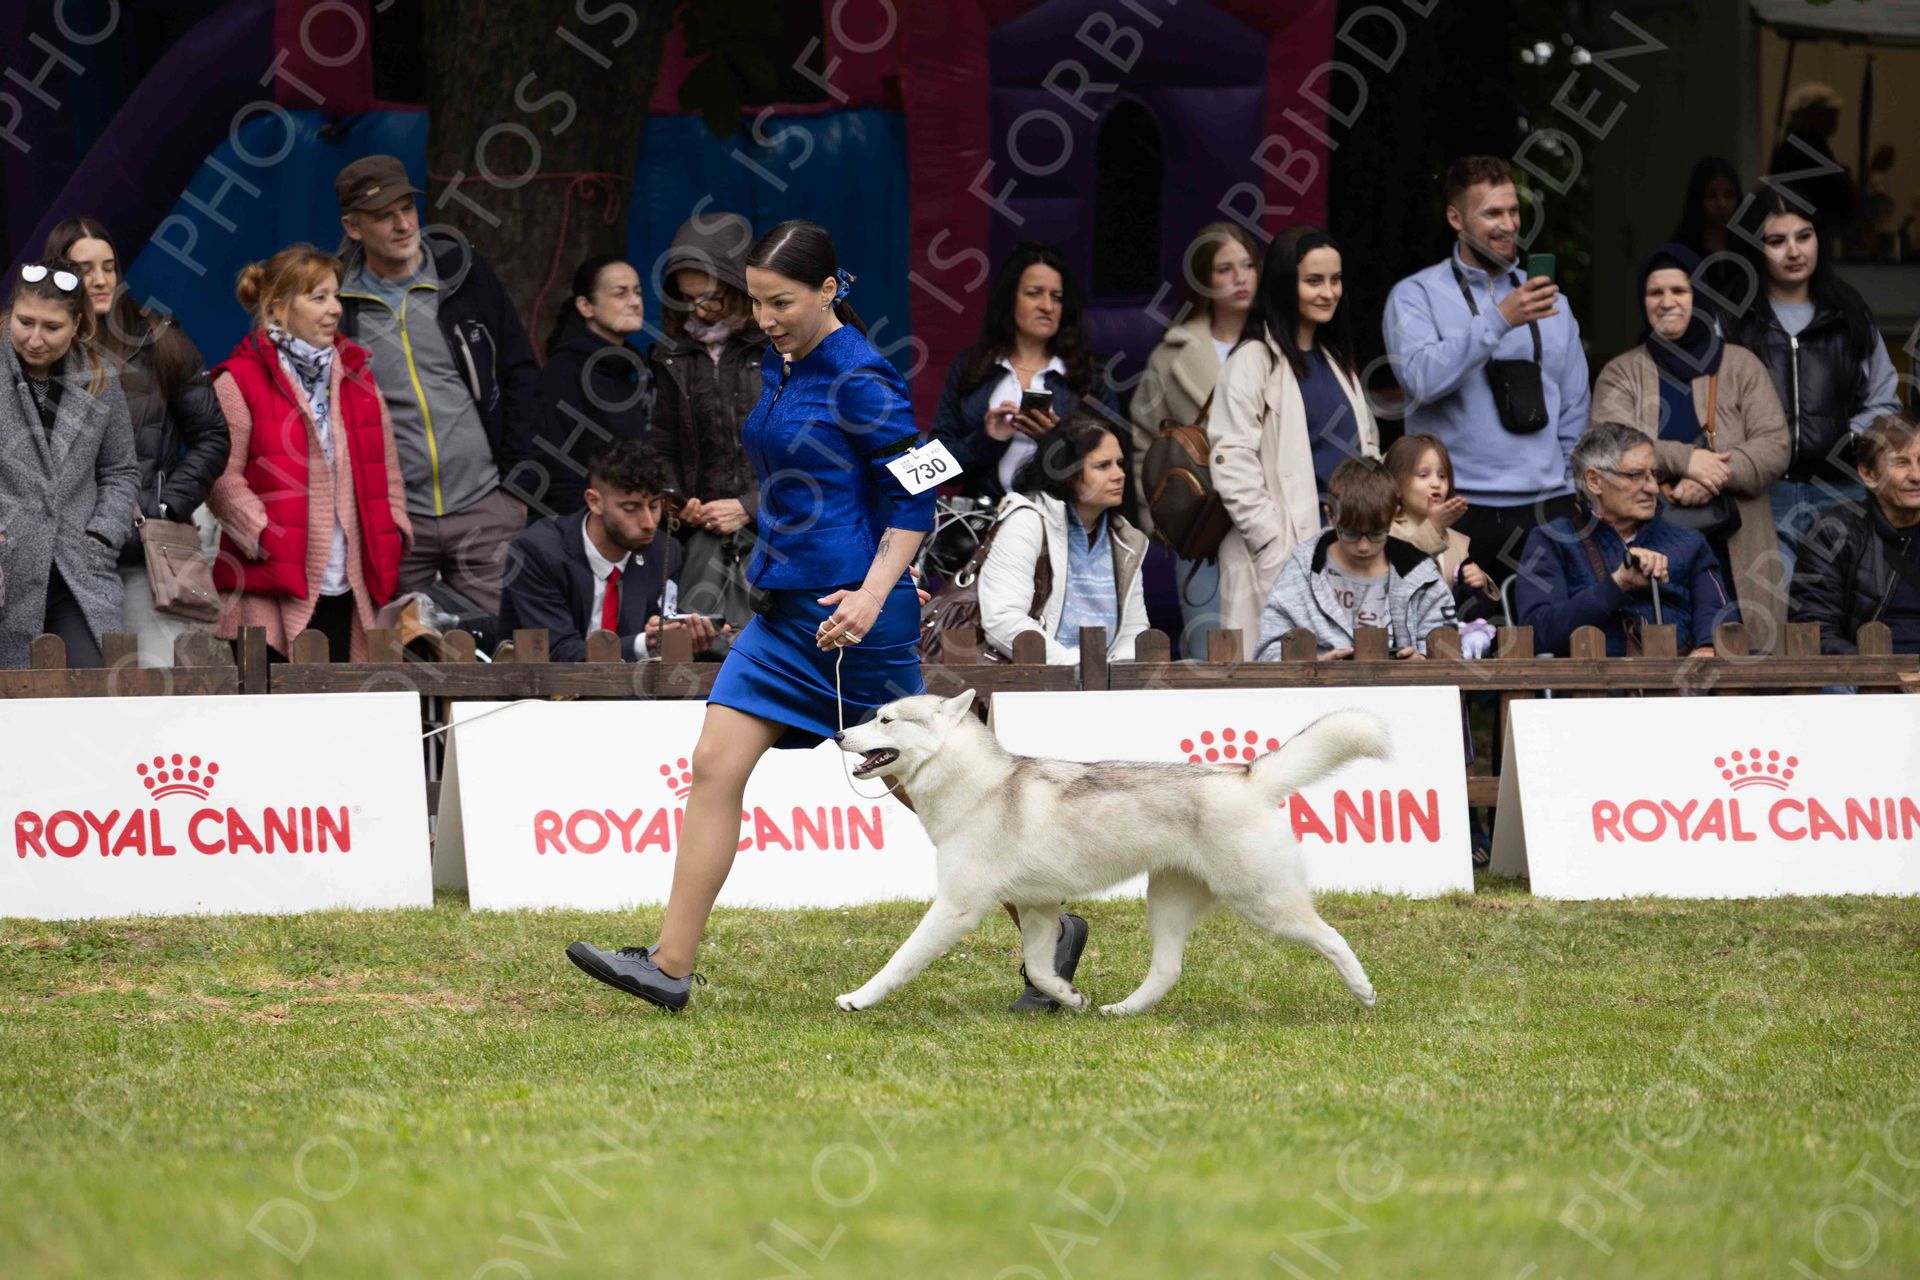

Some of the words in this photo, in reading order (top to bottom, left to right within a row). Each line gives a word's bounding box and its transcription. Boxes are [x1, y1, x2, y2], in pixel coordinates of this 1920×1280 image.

[906, 458, 947, 485] 730
[14, 808, 177, 859] ROYAL
[188, 806, 351, 854] CANIN
[1278, 788, 1440, 844] ANIN
[1591, 798, 1757, 842] ROYAL
